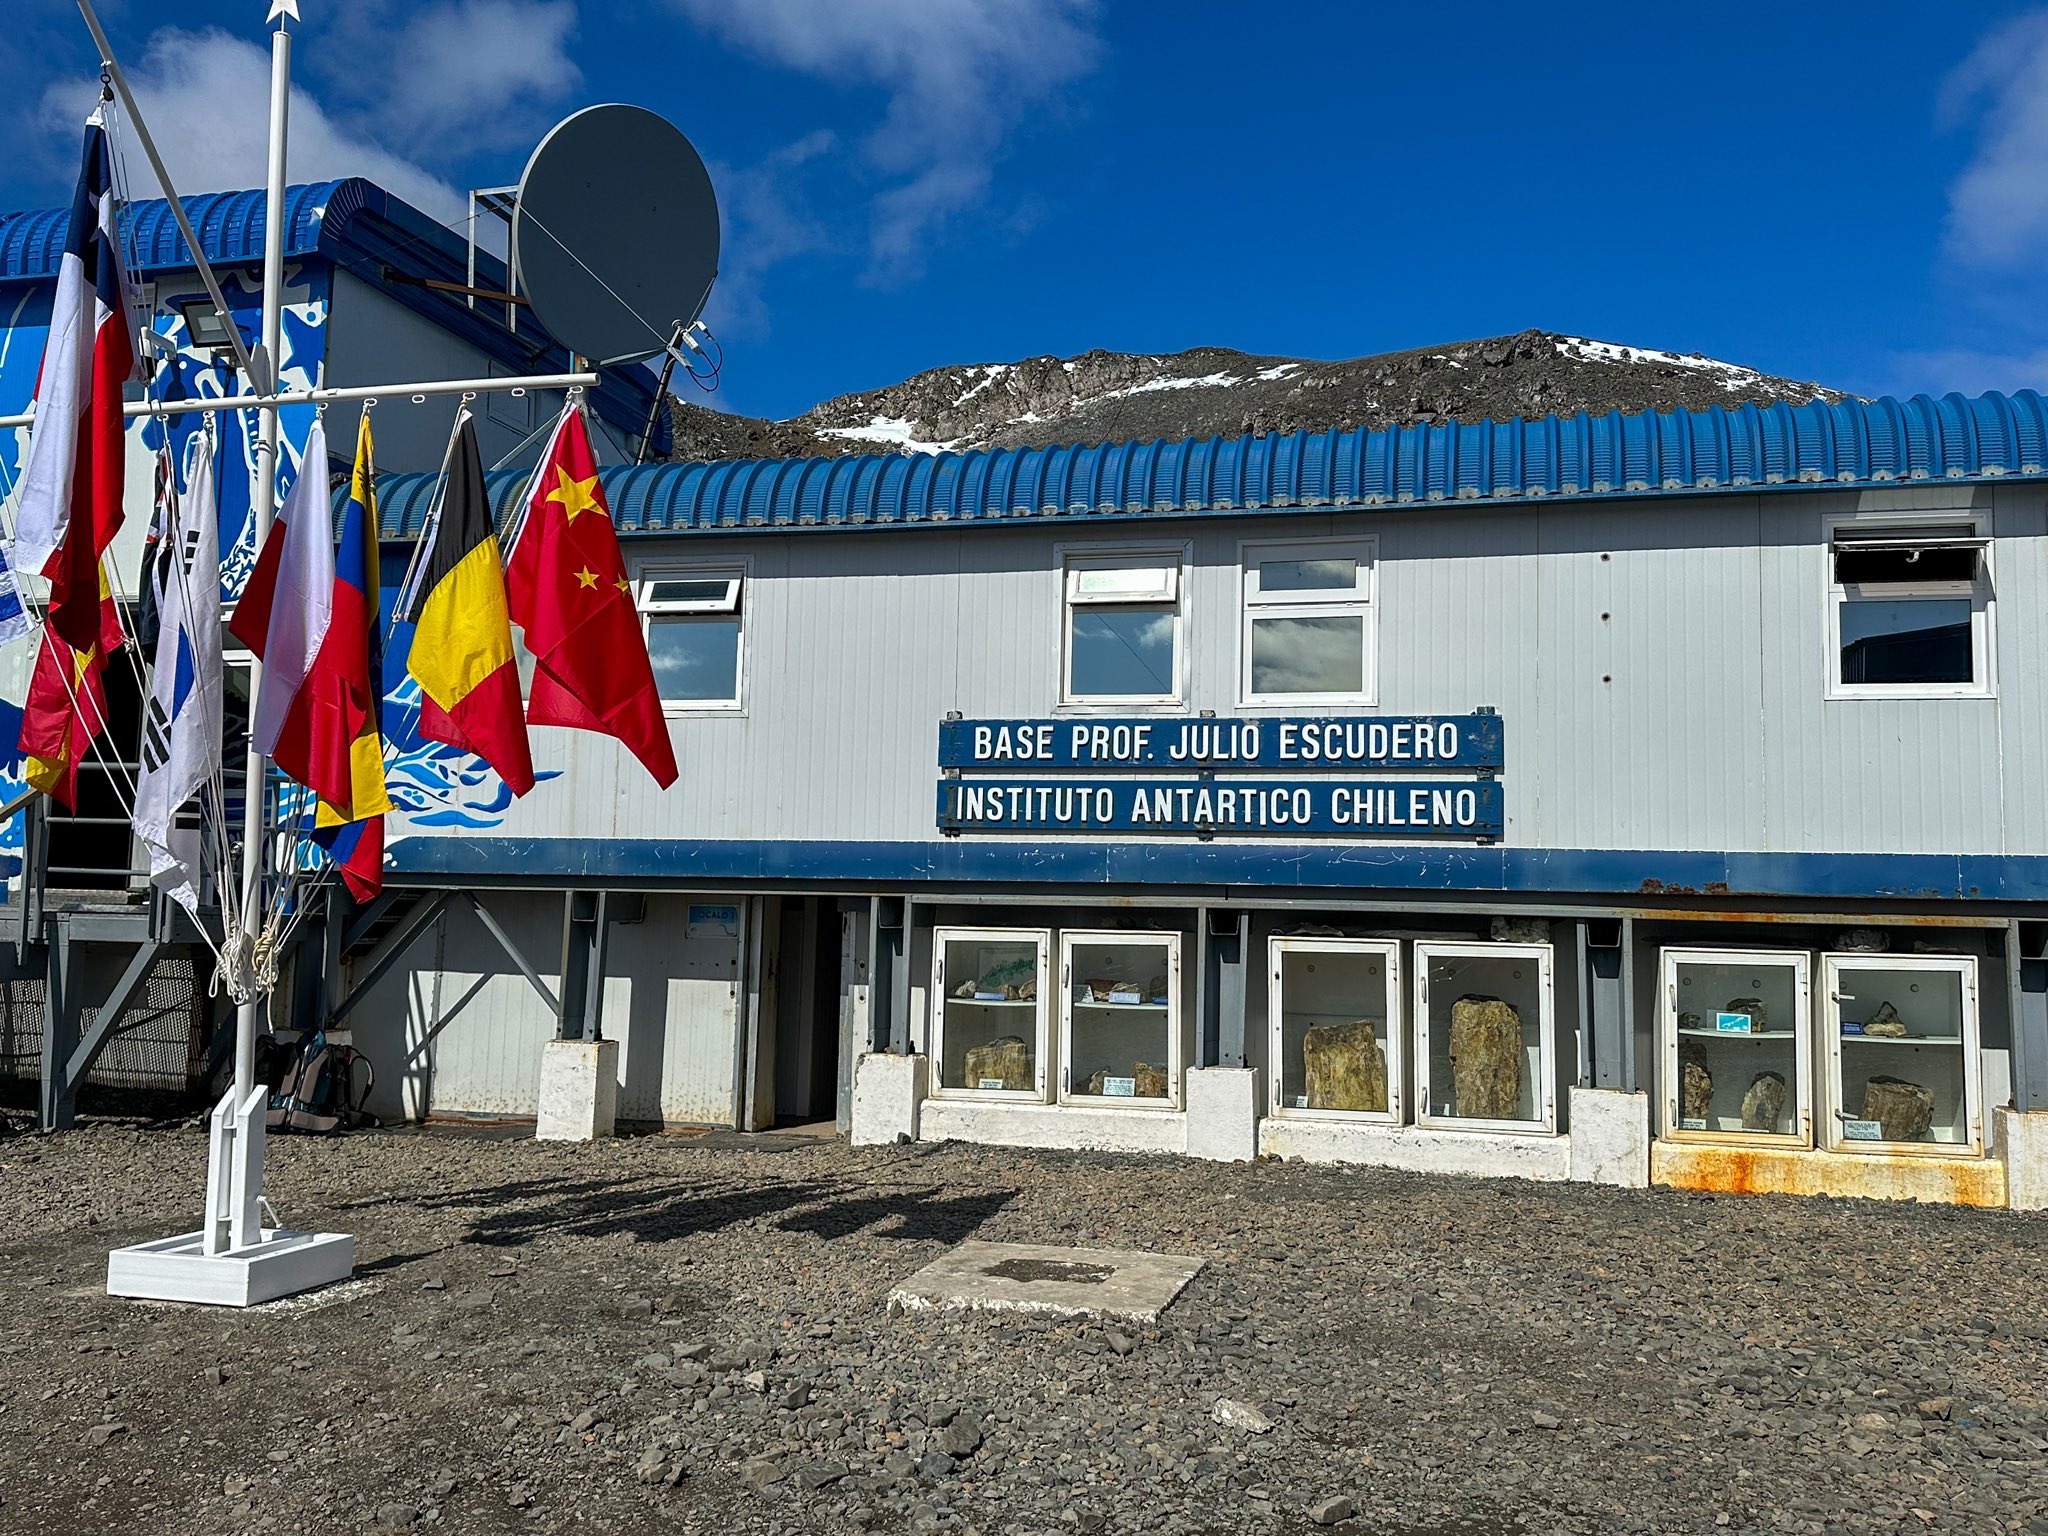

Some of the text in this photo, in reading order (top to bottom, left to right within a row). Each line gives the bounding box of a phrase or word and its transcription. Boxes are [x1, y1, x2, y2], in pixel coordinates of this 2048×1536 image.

[974, 723, 1458, 760] BASE PROF. JULIO ESCUDERO
[956, 786, 1477, 826] INSTITUTO ANTARTICO CHILENO
